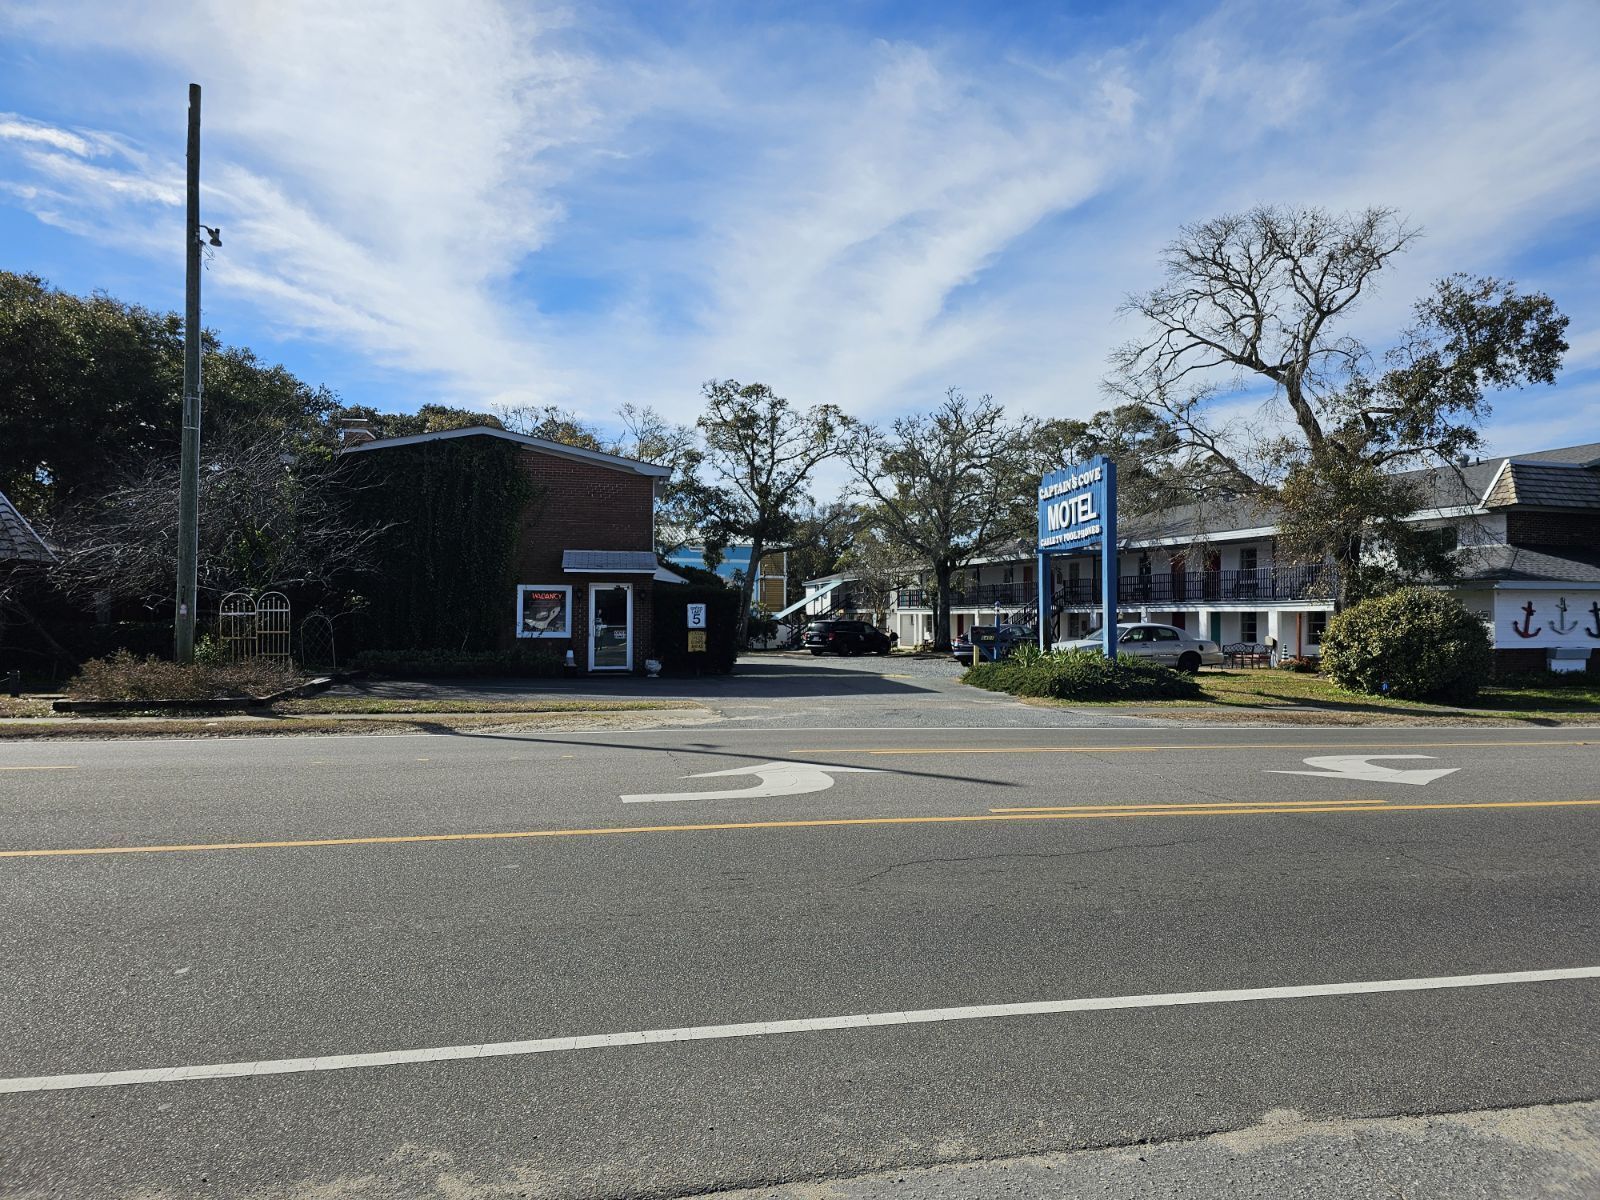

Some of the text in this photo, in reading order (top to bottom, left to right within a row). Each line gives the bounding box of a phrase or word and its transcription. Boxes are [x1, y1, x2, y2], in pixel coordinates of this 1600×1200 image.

[1039, 467, 1102, 500] CAPTAIN'S COVE
[1048, 492, 1098, 531] MOTEL
[692, 613, 701, 625] 5
